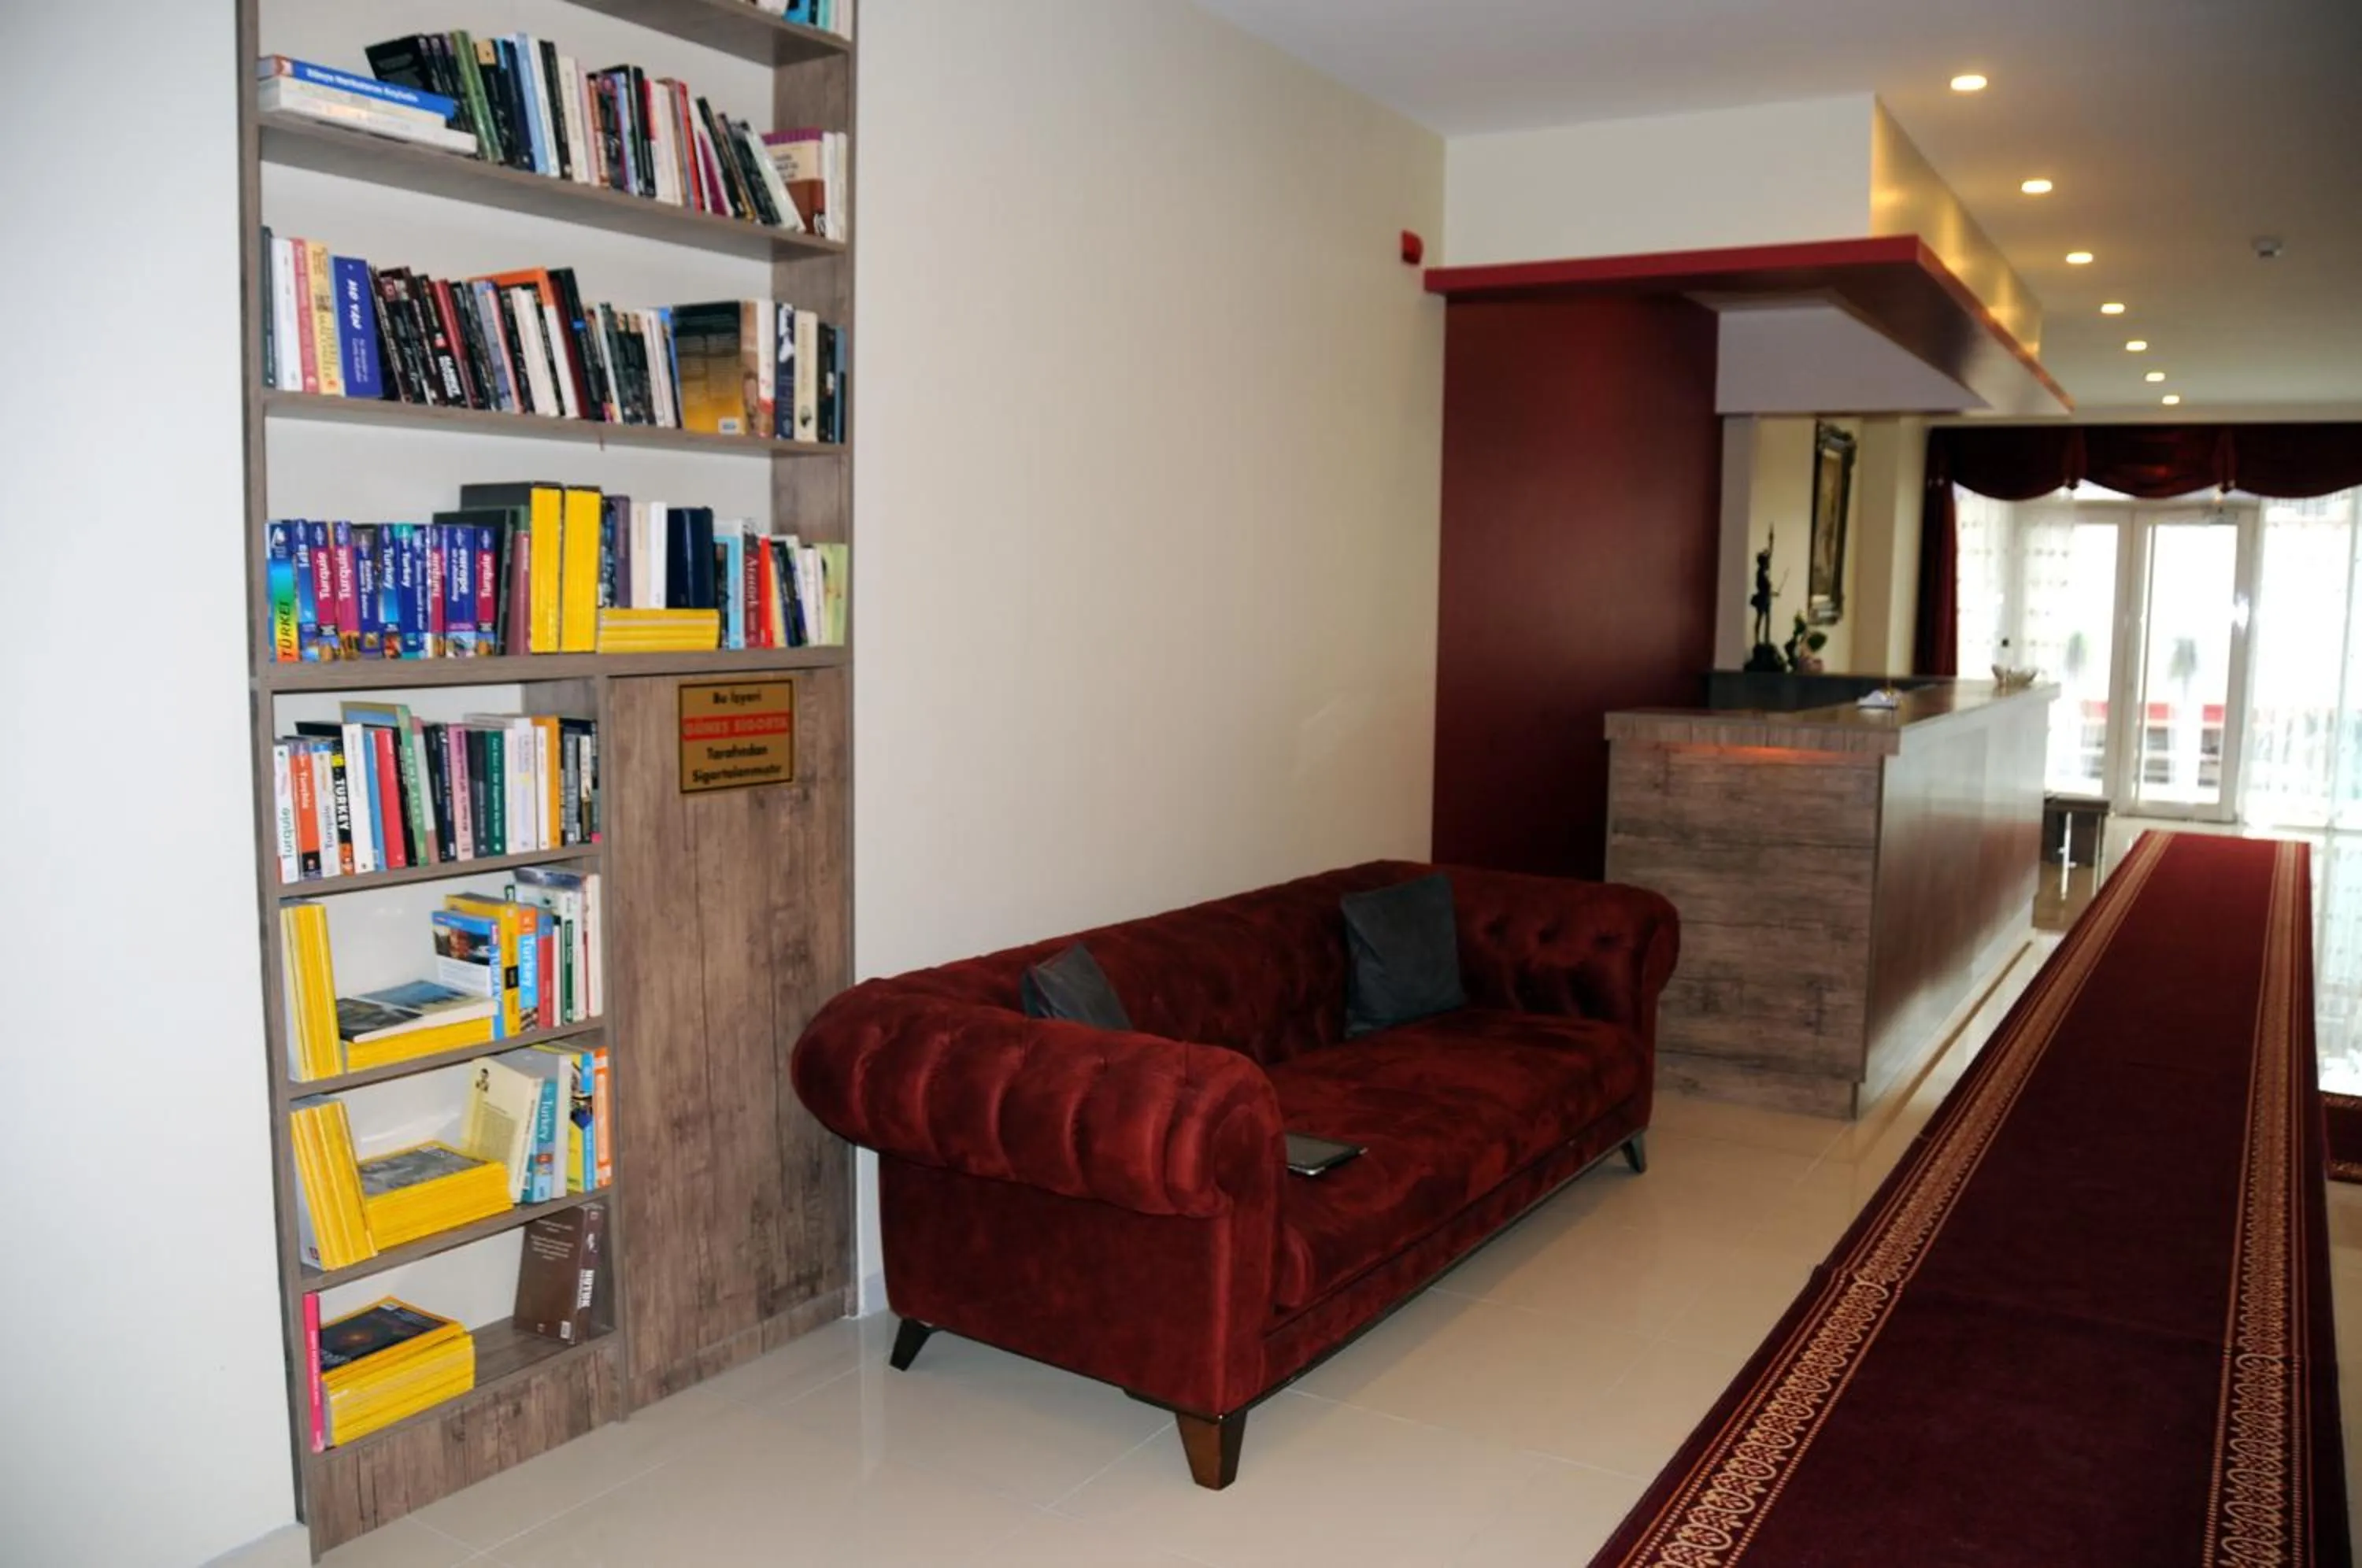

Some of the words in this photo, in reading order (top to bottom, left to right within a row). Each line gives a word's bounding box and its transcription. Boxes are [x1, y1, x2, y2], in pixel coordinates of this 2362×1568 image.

[317, 552, 331, 600] Turquie
[335, 549, 353, 601] Turquie
[383, 547, 394, 590] Turkey
[401, 553, 412, 588] Turkey
[480, 553, 494, 598] Turquie
[335, 778, 350, 830] TURKEY
[280, 807, 294, 859] Turquie
[523, 935, 537, 987] Turkey
[538, 1101, 553, 1139] Turkey
